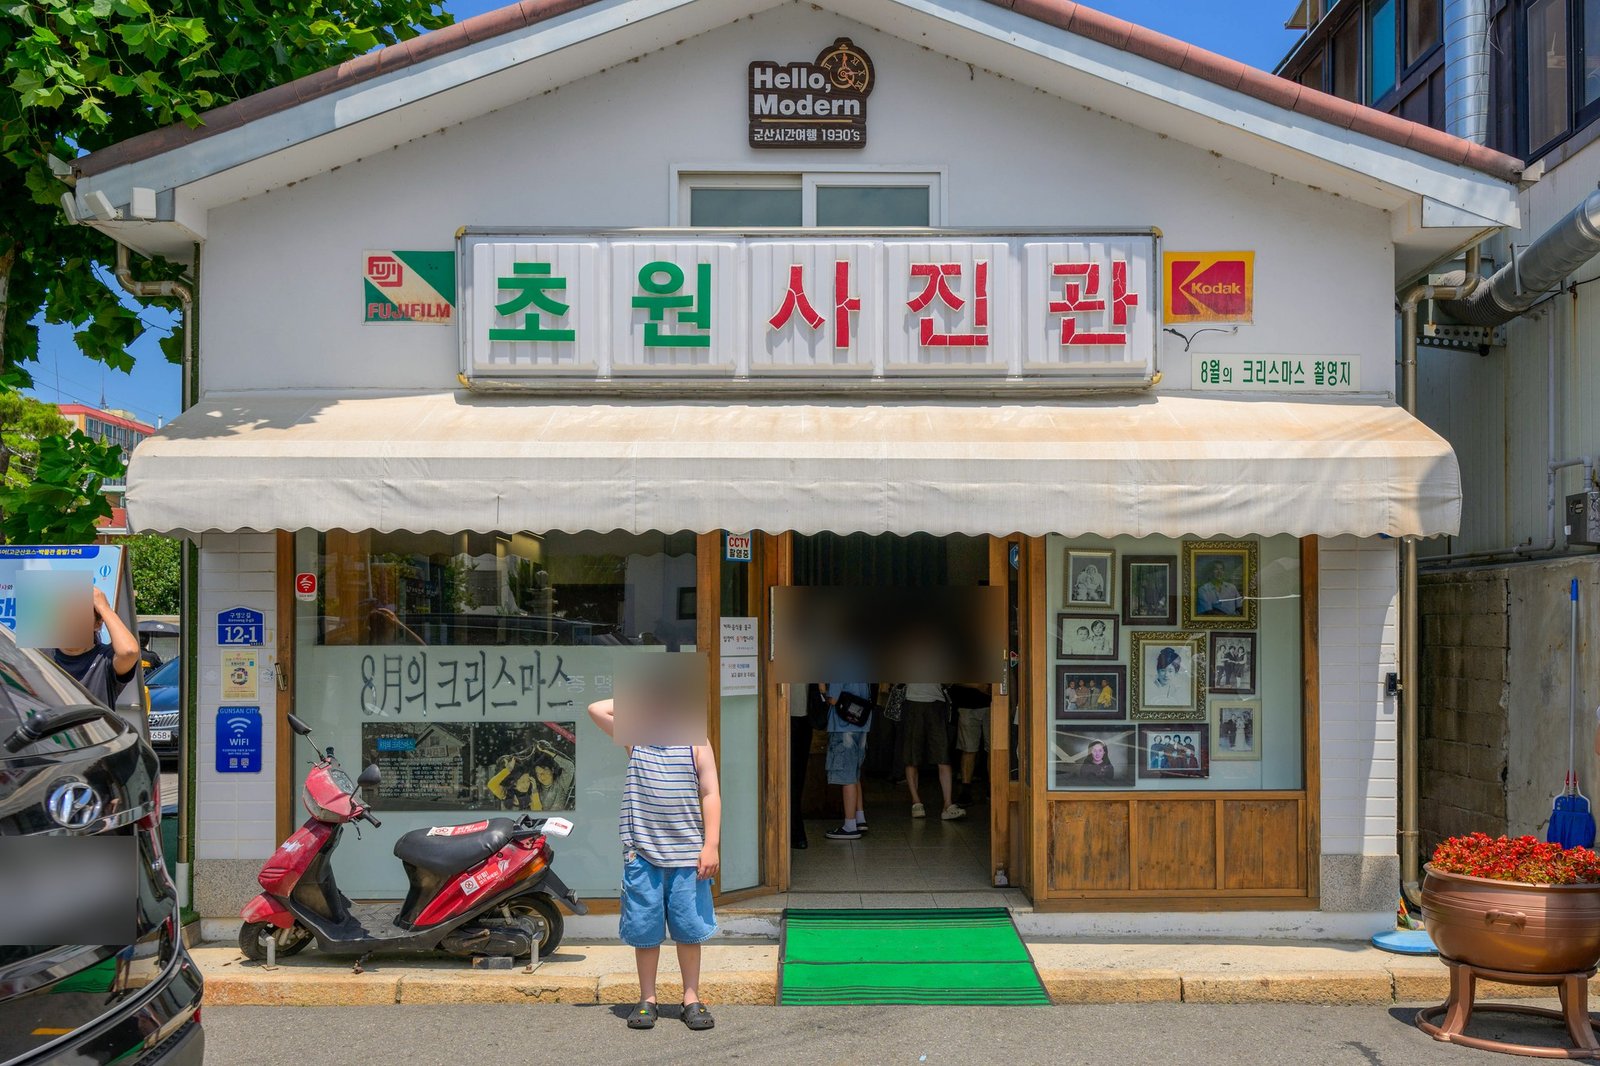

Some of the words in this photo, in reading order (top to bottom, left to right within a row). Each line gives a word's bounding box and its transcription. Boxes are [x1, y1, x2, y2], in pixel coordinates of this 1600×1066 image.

[753, 67, 832, 93] Hello,
[753, 94, 860, 116] Modern
[754, 128, 817, 142] 군산시간여행
[821, 128, 860, 141] 1930's
[1191, 282, 1242, 295] Kodak
[367, 302, 451, 319] FUJIFILM
[1200, 359, 1233, 385] 8월의
[1242, 359, 1305, 386] 크리스마스
[1314, 360, 1351, 386] 촬영지
[729, 536, 750, 549] CCTV
[729, 548, 749, 559] 촬영중
[224, 626, 258, 643] 12-1
[229, 738, 249, 746] WIFI
